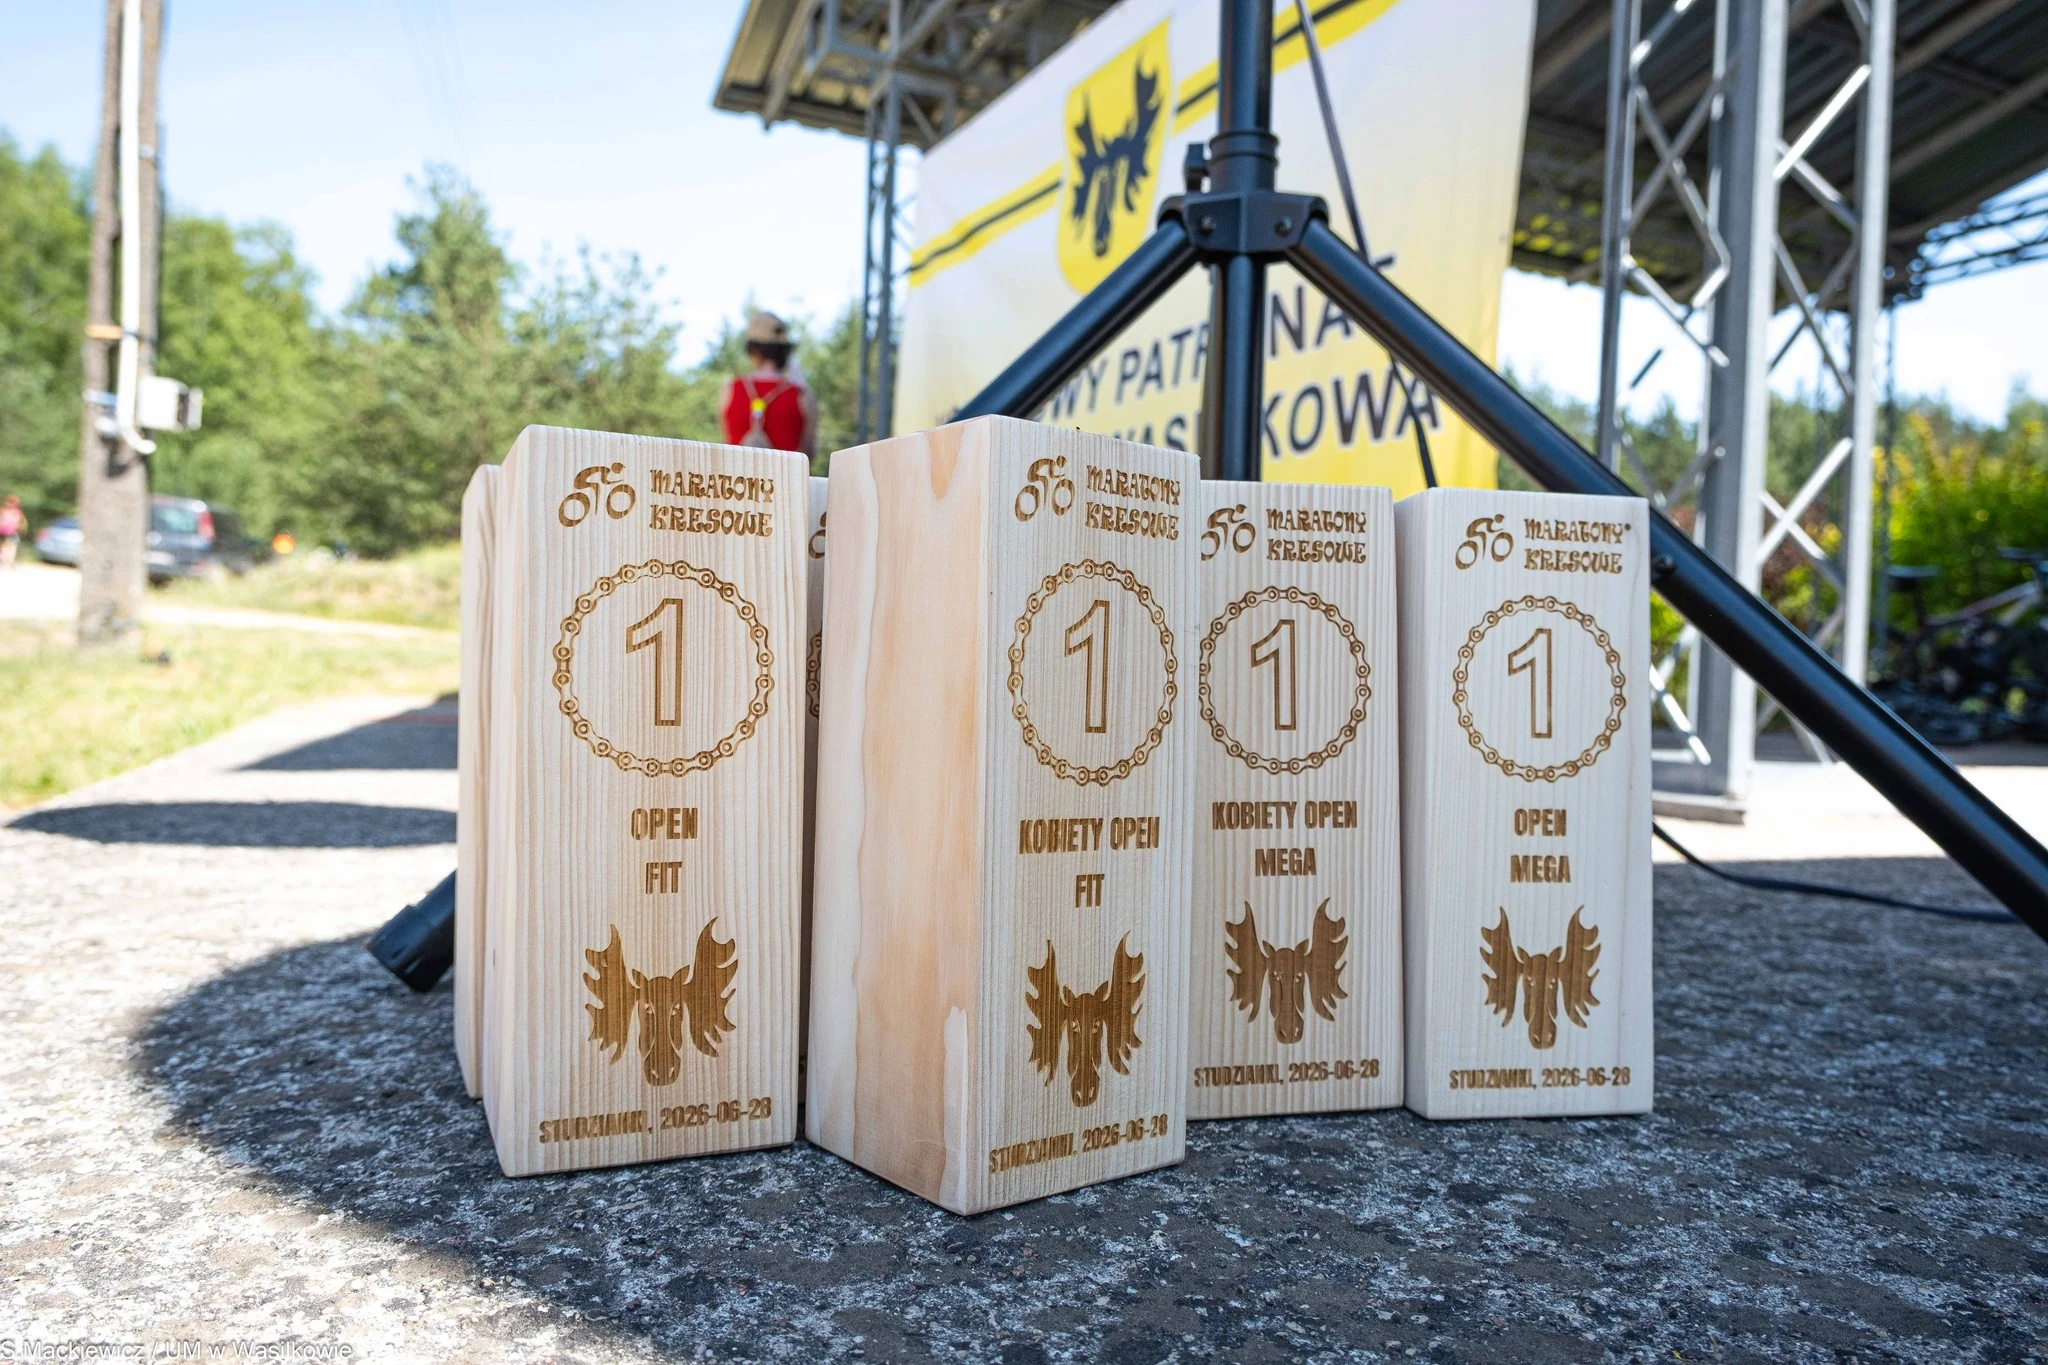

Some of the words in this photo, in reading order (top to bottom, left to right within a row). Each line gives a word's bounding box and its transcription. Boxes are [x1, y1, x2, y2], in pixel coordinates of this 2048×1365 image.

[649, 469, 774, 504] MARATONY
[1086, 464, 1181, 506] MARATONY
[649, 504, 773, 537] KRESOWE
[1085, 502, 1180, 541] KRESOWE
[1266, 508, 1367, 534] MARATONY
[1524, 518, 1623, 544] MARATONY
[1266, 540, 1367, 564] KRESOWE
[1524, 549, 1623, 574] KRESOWE
[625, 598, 684, 727] 1
[1064, 599, 1111, 733] 1
[1251, 619, 1296, 731] 1
[1508, 628, 1552, 739] 1
[631, 807, 698, 841] OPEN
[1212, 801, 1298, 831] KOBIETY
[1304, 800, 1358, 829] OPEN
[1513, 808, 1567, 837] OPEN
[1019, 817, 1104, 854] KOBIETY
[1109, 816, 1160, 850] OPEN
[645, 861, 683, 894] FIT
[1255, 847, 1317, 877] MEGA
[1510, 855, 1571, 883] MEGA
[1075, 873, 1105, 908] FIT
[1193, 1063, 1284, 1087] STUDZIANKI,
[1289, 1058, 1380, 1083] 2026-06-28
[1449, 1068, 1537, 1090] STUDZIANKI,
[1541, 1066, 1631, 1088] 2026-06-28
[660, 1096, 772, 1130] 2026-06-28
[1082, 1113, 1168, 1152] 2026-06-28
